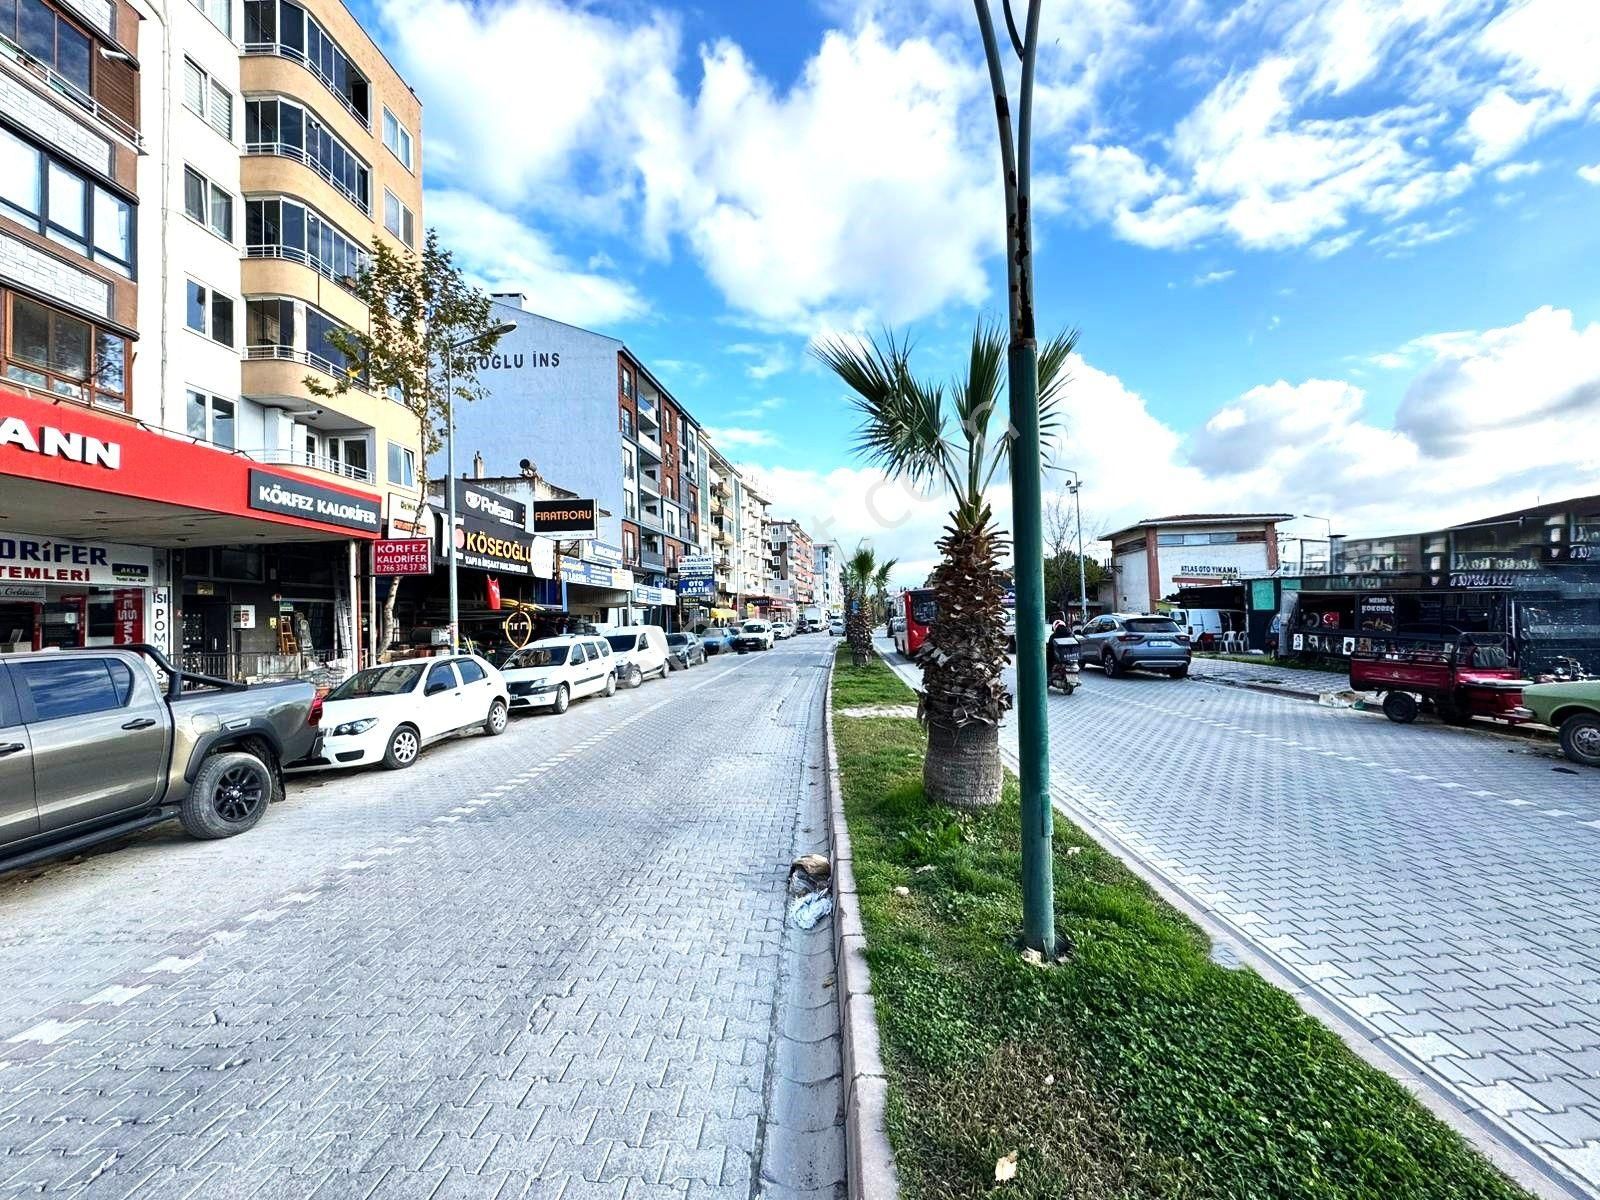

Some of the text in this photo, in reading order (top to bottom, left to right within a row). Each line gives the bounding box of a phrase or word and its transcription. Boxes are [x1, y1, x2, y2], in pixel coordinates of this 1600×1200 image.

[259, 484, 377, 525] KÖRFEZ KALORİFER
[480, 495, 514, 521] Polisan
[377, 542, 427, 553] KÖRFEZ
[466, 530, 532, 563] KÖSEOĞLU
[377, 553, 427, 564] KALORİFER
[383, 564, 395, 572] 266
[1198, 565, 1211, 573] OTO
[1211, 565, 1238, 574] YIKAMA
